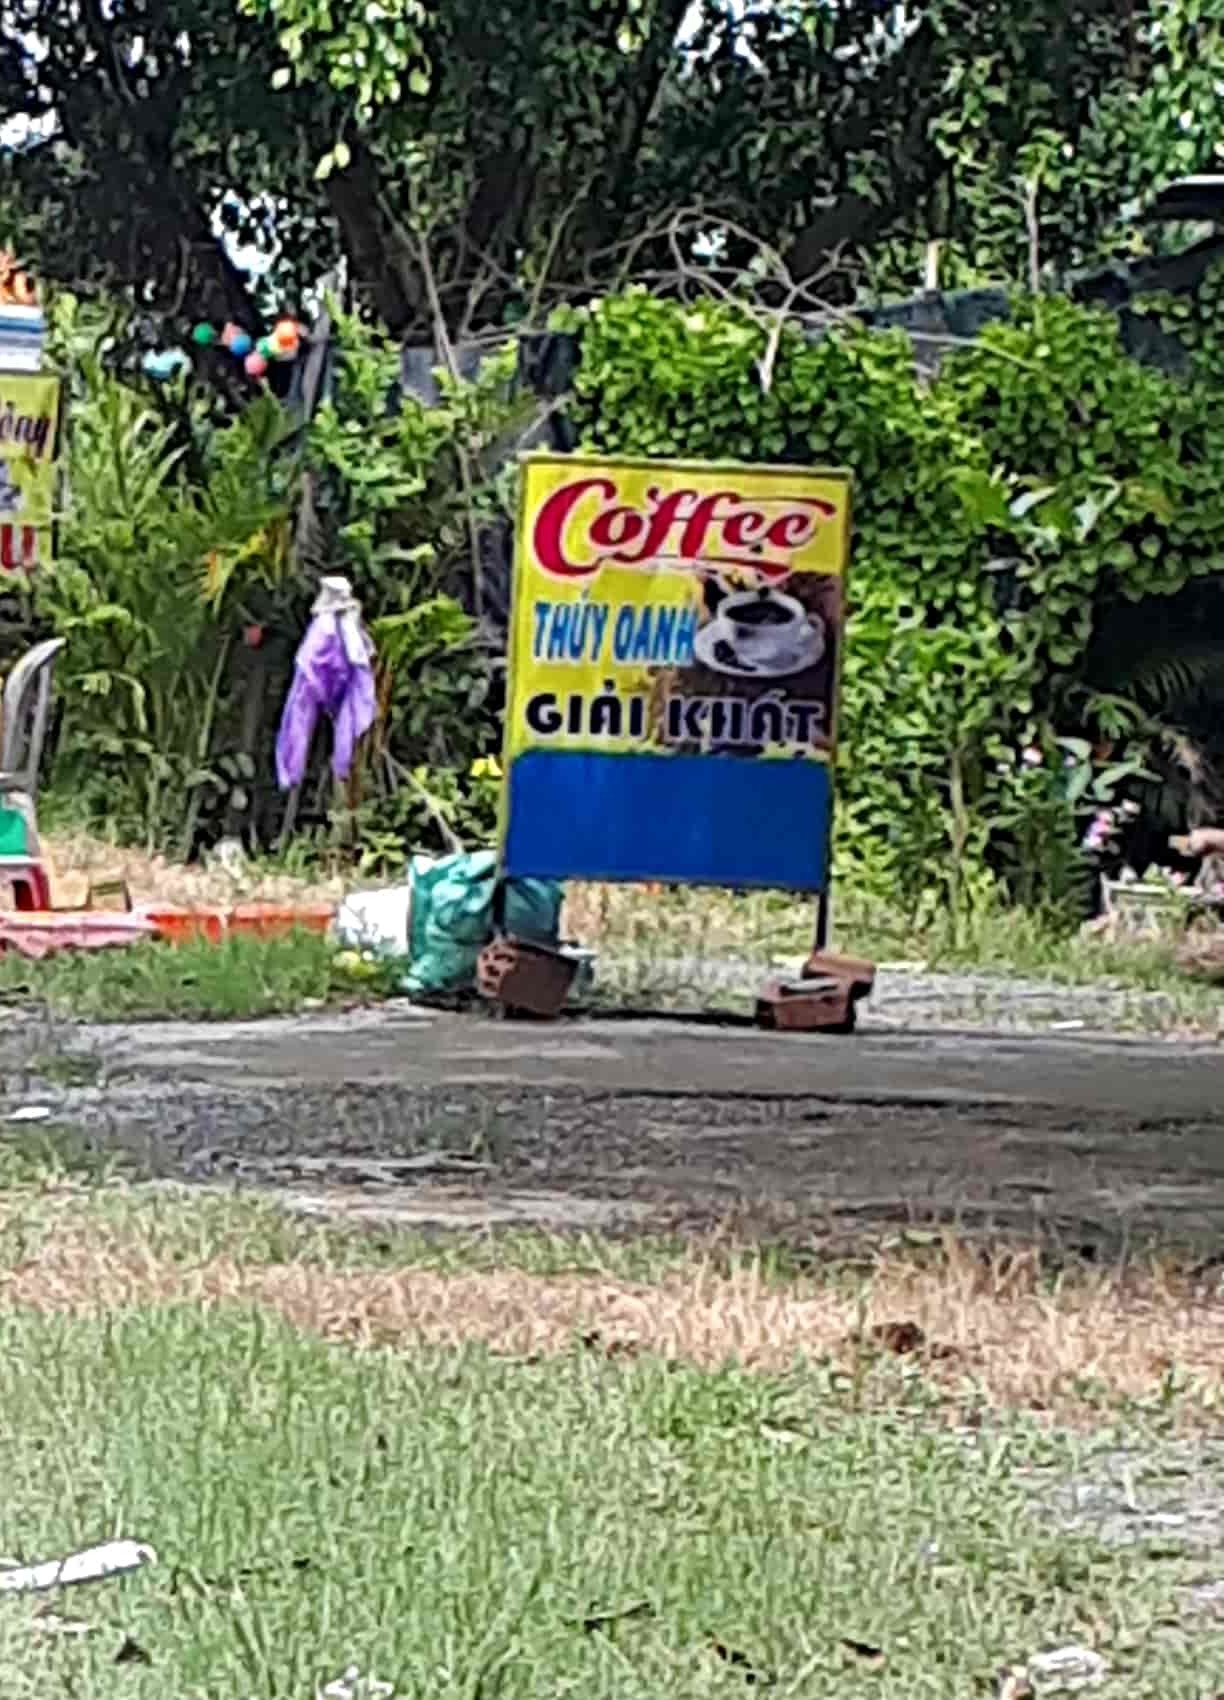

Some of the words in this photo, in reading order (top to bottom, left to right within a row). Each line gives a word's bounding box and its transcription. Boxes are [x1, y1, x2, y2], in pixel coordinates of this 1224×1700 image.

[533, 478, 836, 577] Coffee
[614, 604, 697, 663] OANH
[526, 679, 644, 737] GIẢI
[668, 690, 821, 743] KHÁT
